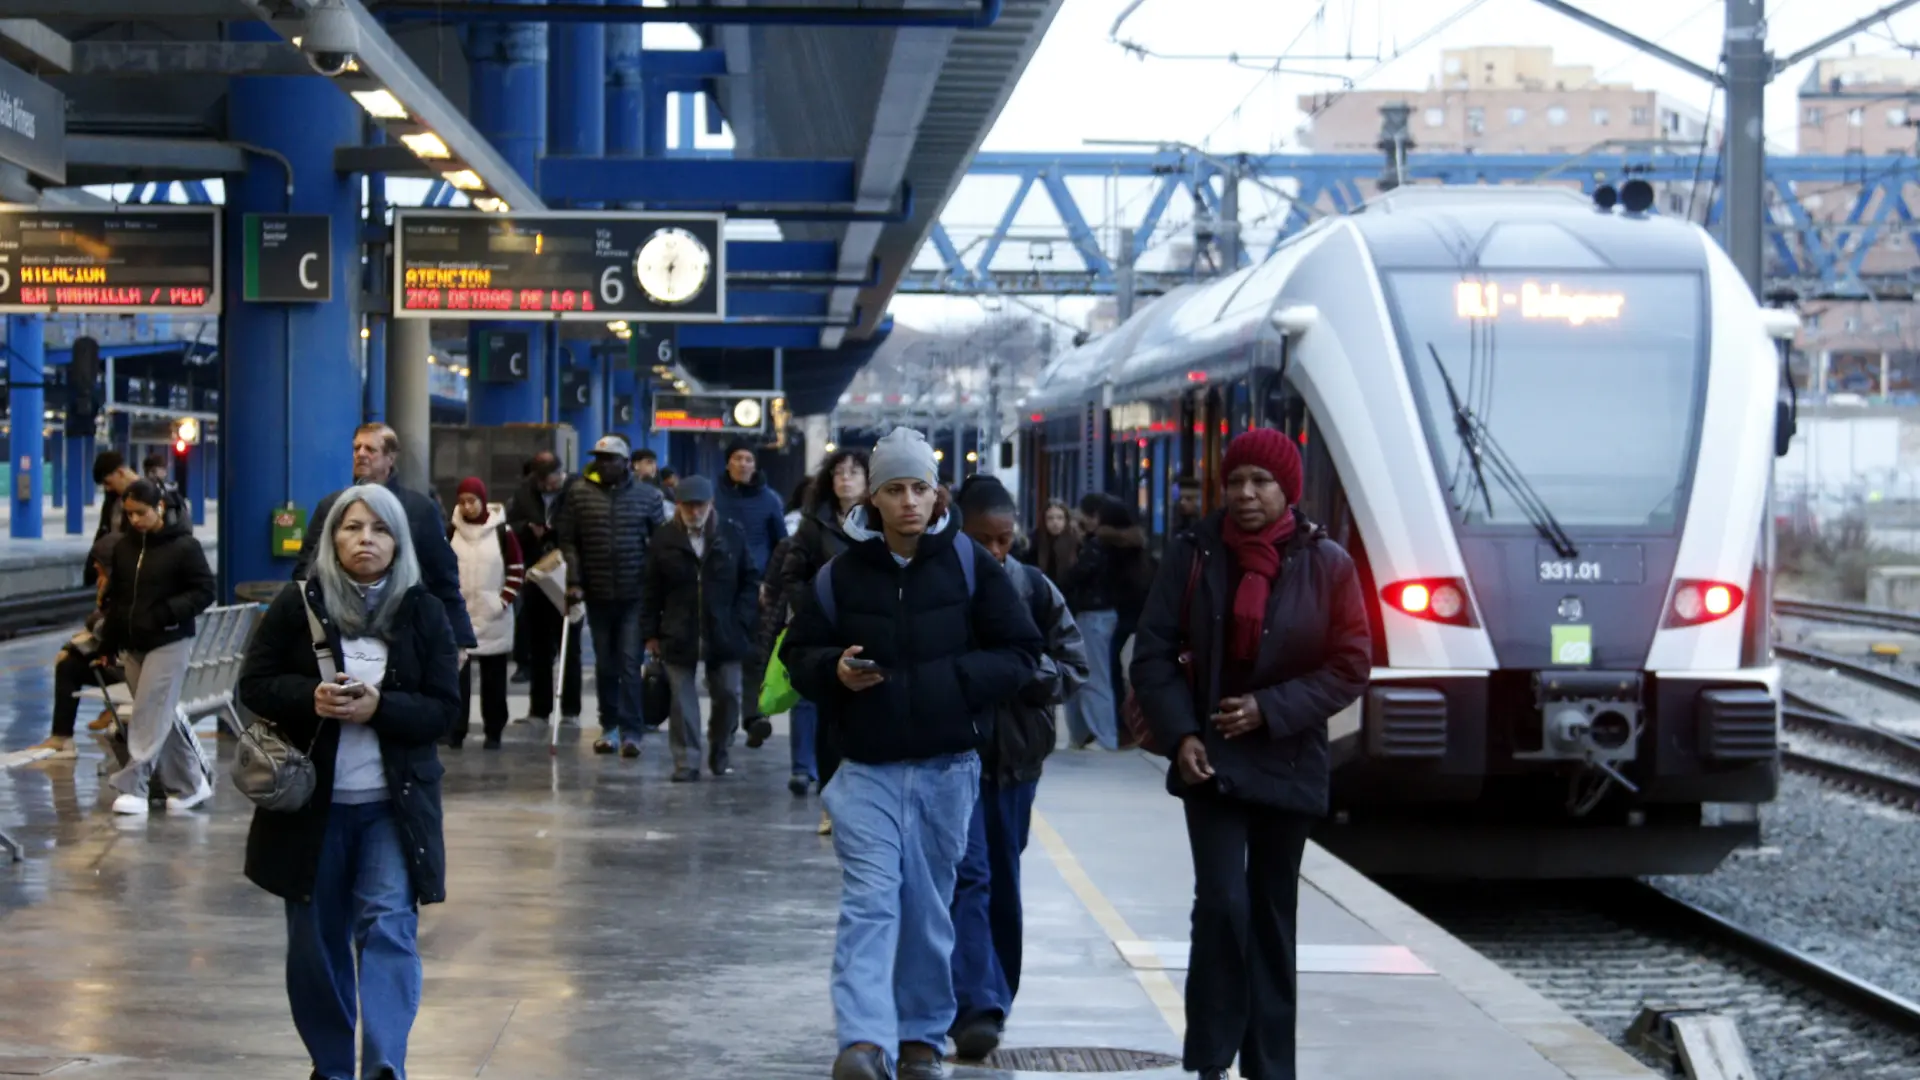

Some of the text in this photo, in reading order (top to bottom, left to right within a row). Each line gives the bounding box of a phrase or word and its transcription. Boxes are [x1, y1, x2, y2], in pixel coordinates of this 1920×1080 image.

[299, 252, 318, 290] C
[405, 268, 492, 288] ATENCION
[600, 265, 624, 304] 6
[448, 288, 513, 309] DETRAS
[519, 289, 543, 310] DE
[550, 289, 576, 311] LA
[657, 340, 672, 363] 6
[509, 352, 522, 376] C
[577, 384, 587, 404] C
[1540, 561, 1601, 580] 331.01
